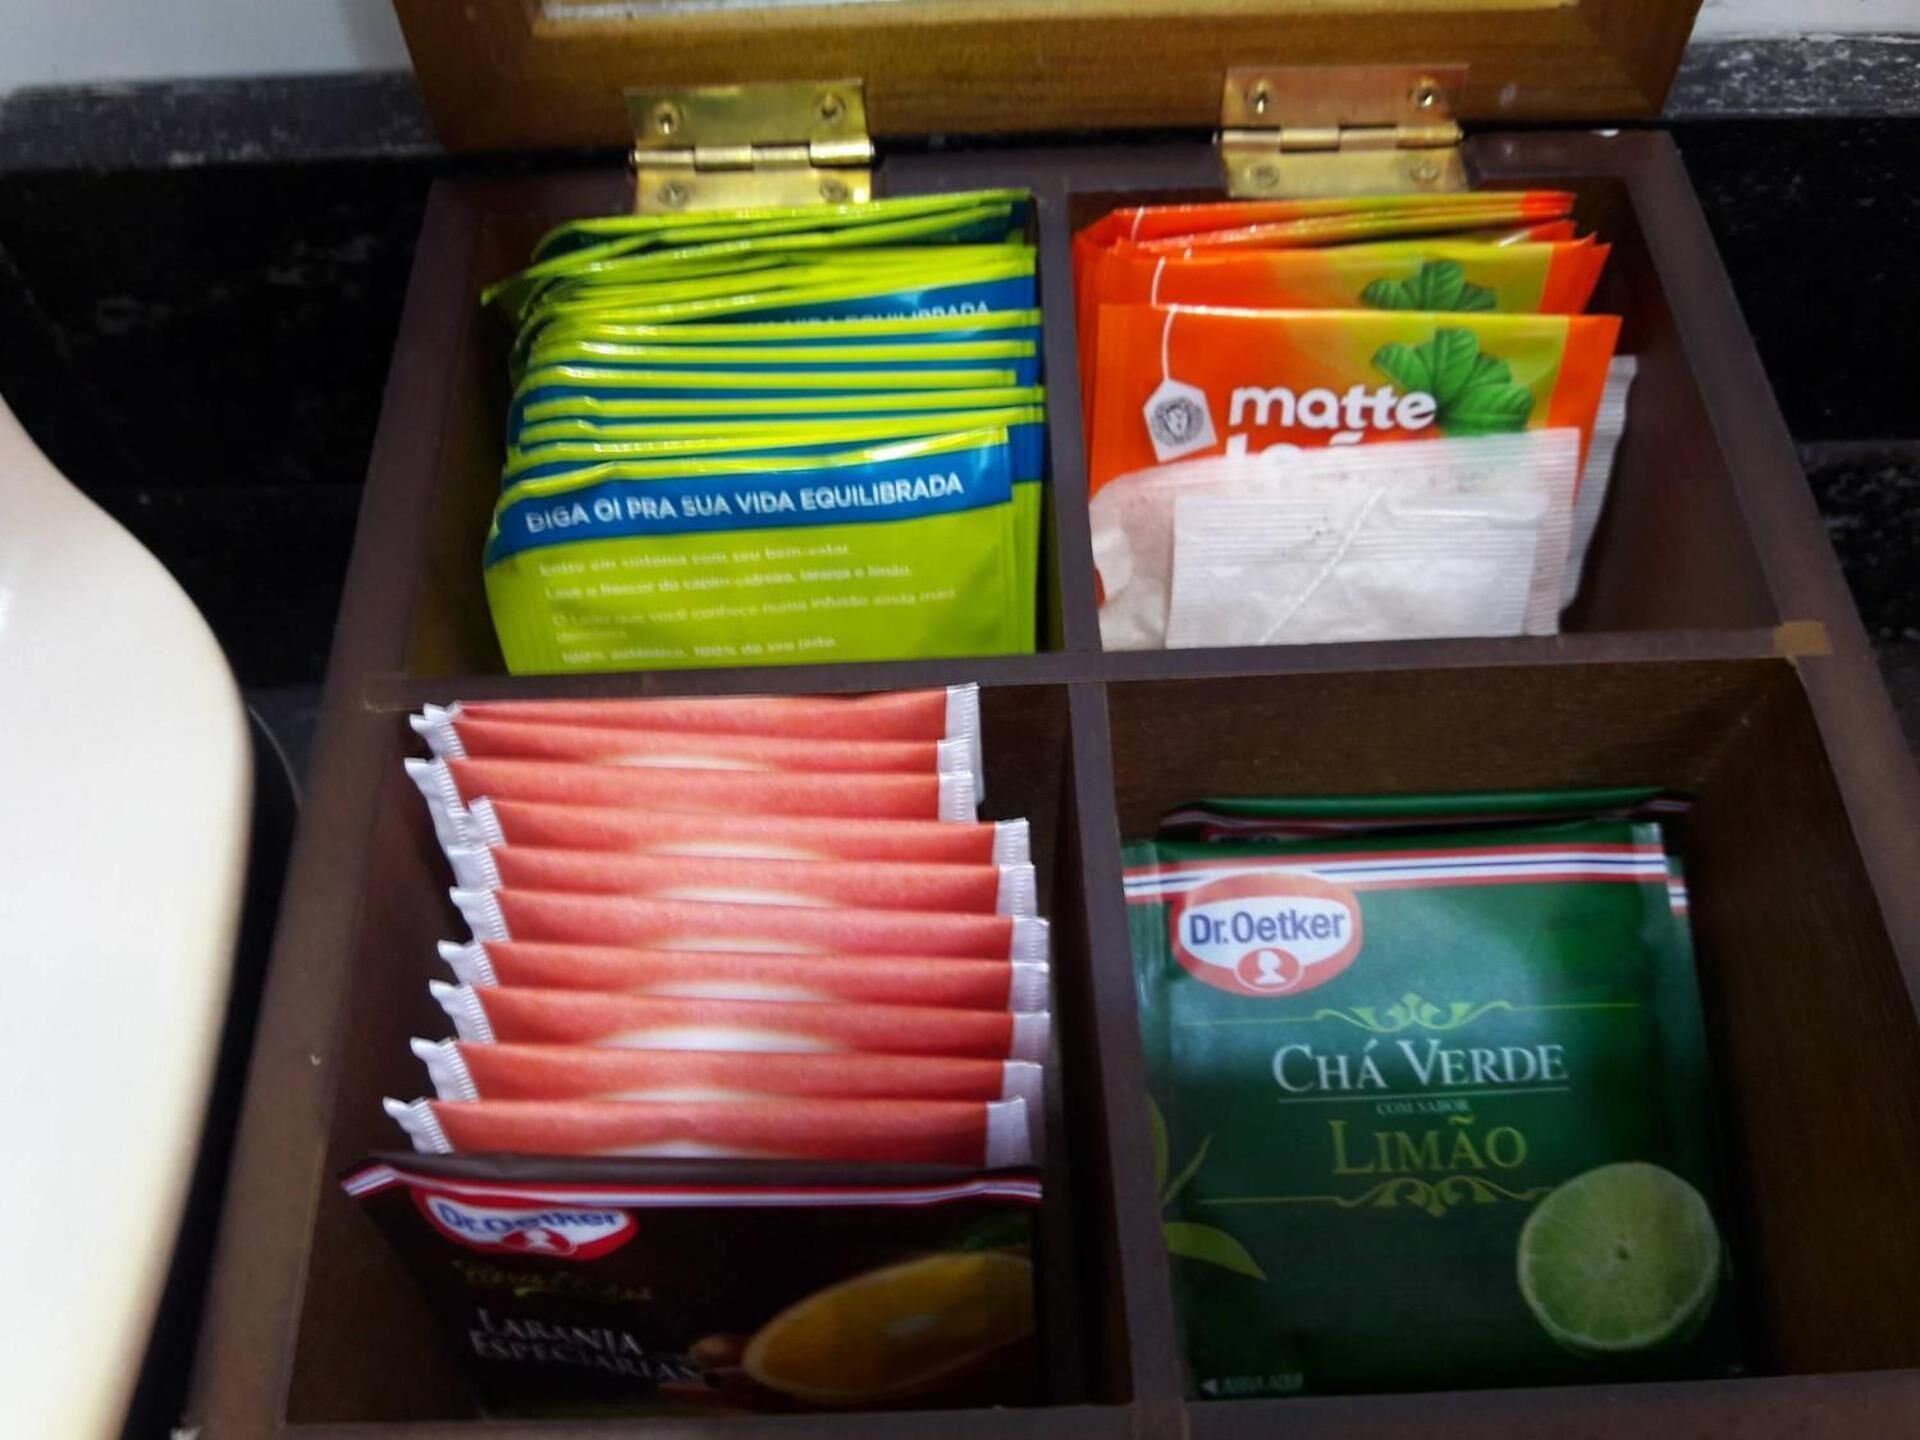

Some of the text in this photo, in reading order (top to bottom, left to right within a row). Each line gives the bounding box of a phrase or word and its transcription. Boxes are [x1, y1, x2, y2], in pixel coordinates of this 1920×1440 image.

[1229, 384, 1437, 430] matte
[525, 471, 964, 533] DIGA OI PRA SUA VIDA EQUILIBRADA
[1189, 909, 1345, 946] Dr.Oetker
[1272, 1038, 1569, 1092] CHÁ VERDE
[1328, 1115, 1527, 1174] LIMÃO
